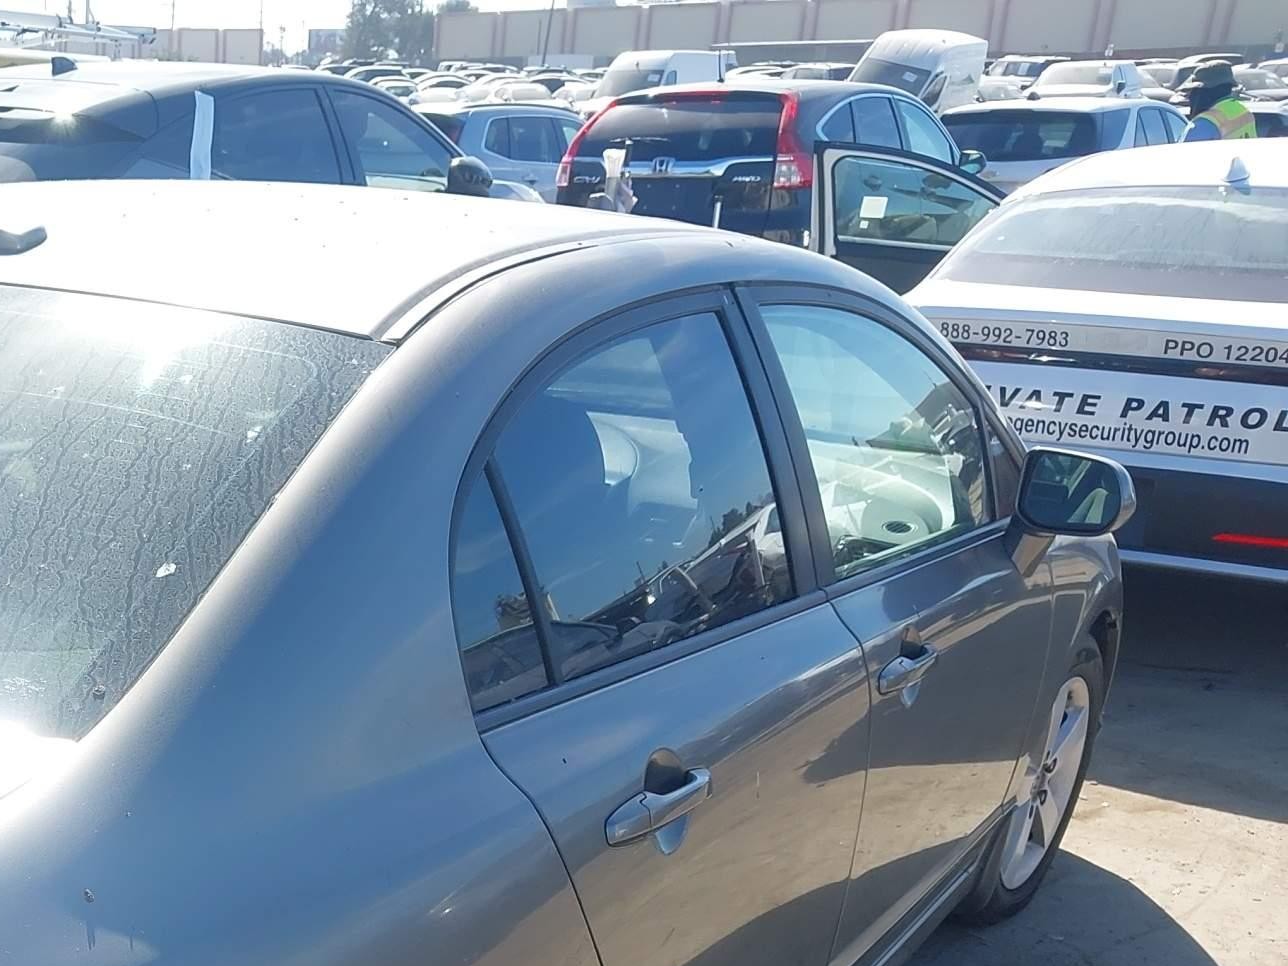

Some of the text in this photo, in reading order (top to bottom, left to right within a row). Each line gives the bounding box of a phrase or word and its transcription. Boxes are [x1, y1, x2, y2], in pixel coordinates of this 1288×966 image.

[940, 322, 1069, 347] 888-992-7983
[1163, 339, 1288, 363] PPO 12204
[985, 384, 1288, 432] VATE PATROL
